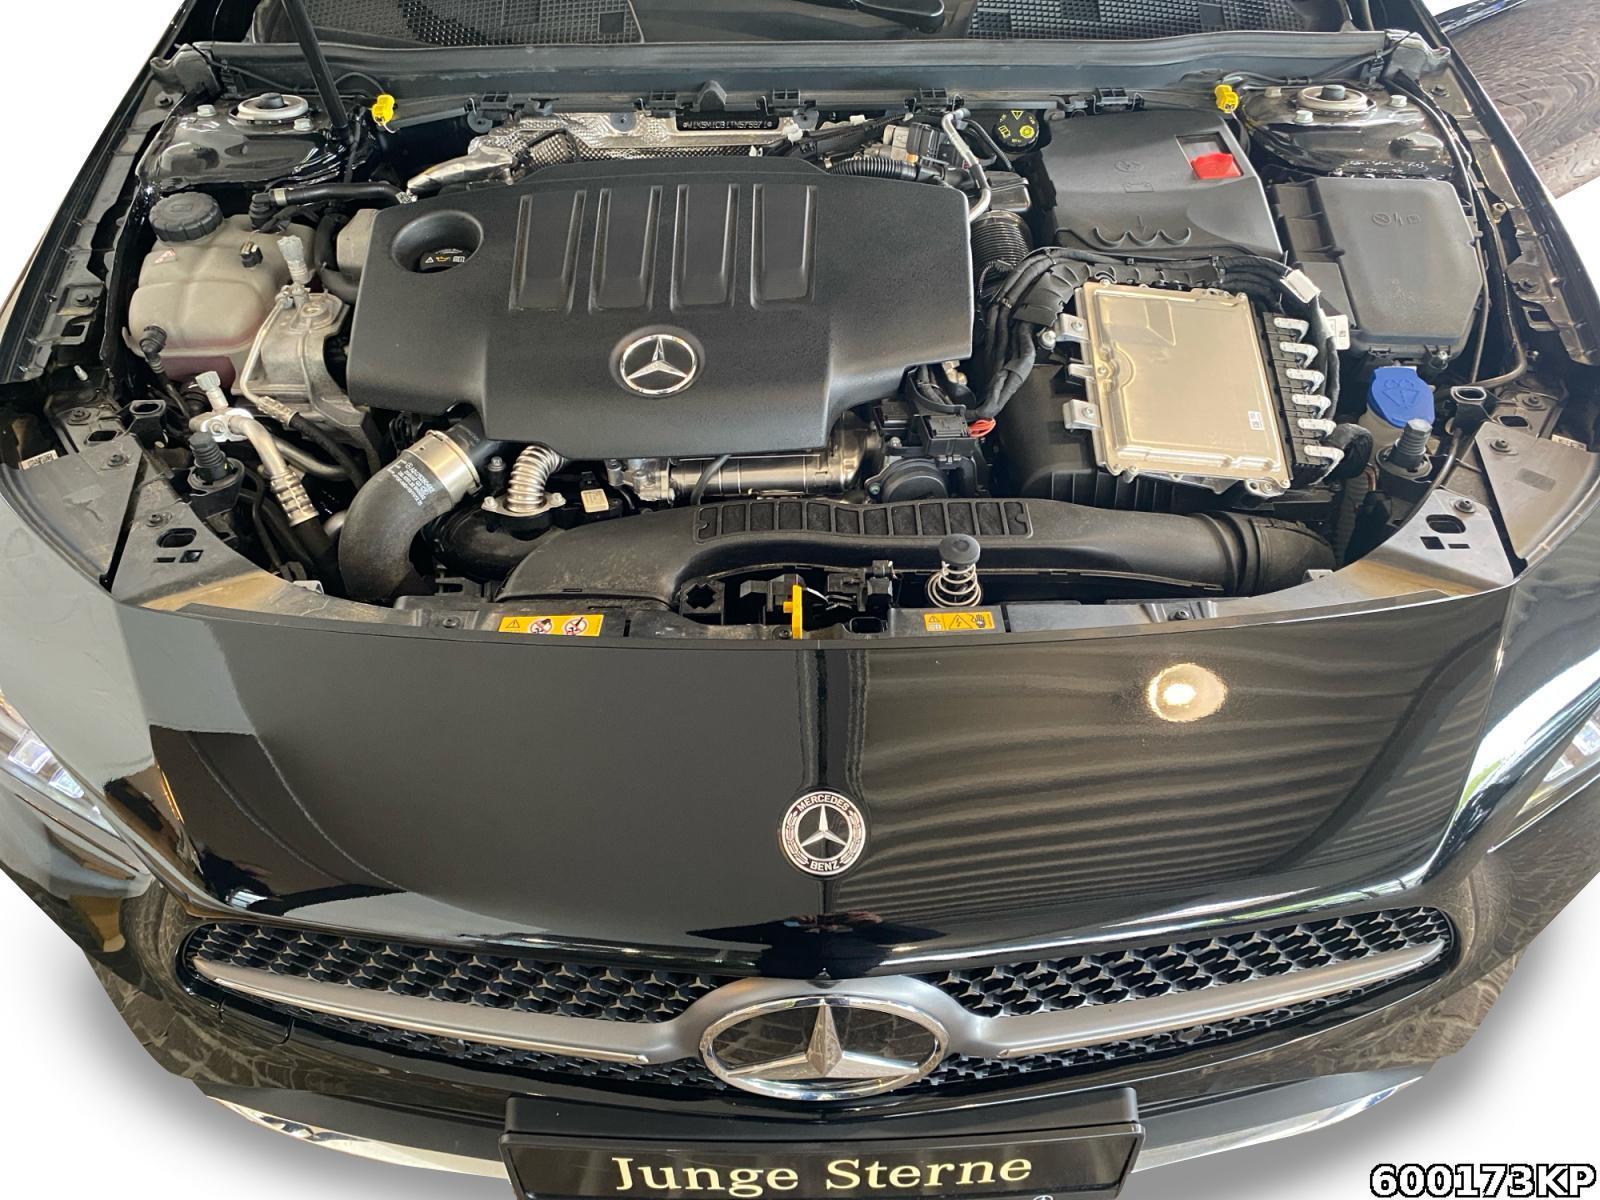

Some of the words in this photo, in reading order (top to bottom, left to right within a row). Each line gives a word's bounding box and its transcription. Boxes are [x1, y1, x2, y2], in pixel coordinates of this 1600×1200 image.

[797, 794, 850, 812] MERCEDES
[810, 860, 840, 872] BENZ
[611, 1157, 799, 1197] Junge
[826, 1157, 1033, 1190] Sterne
